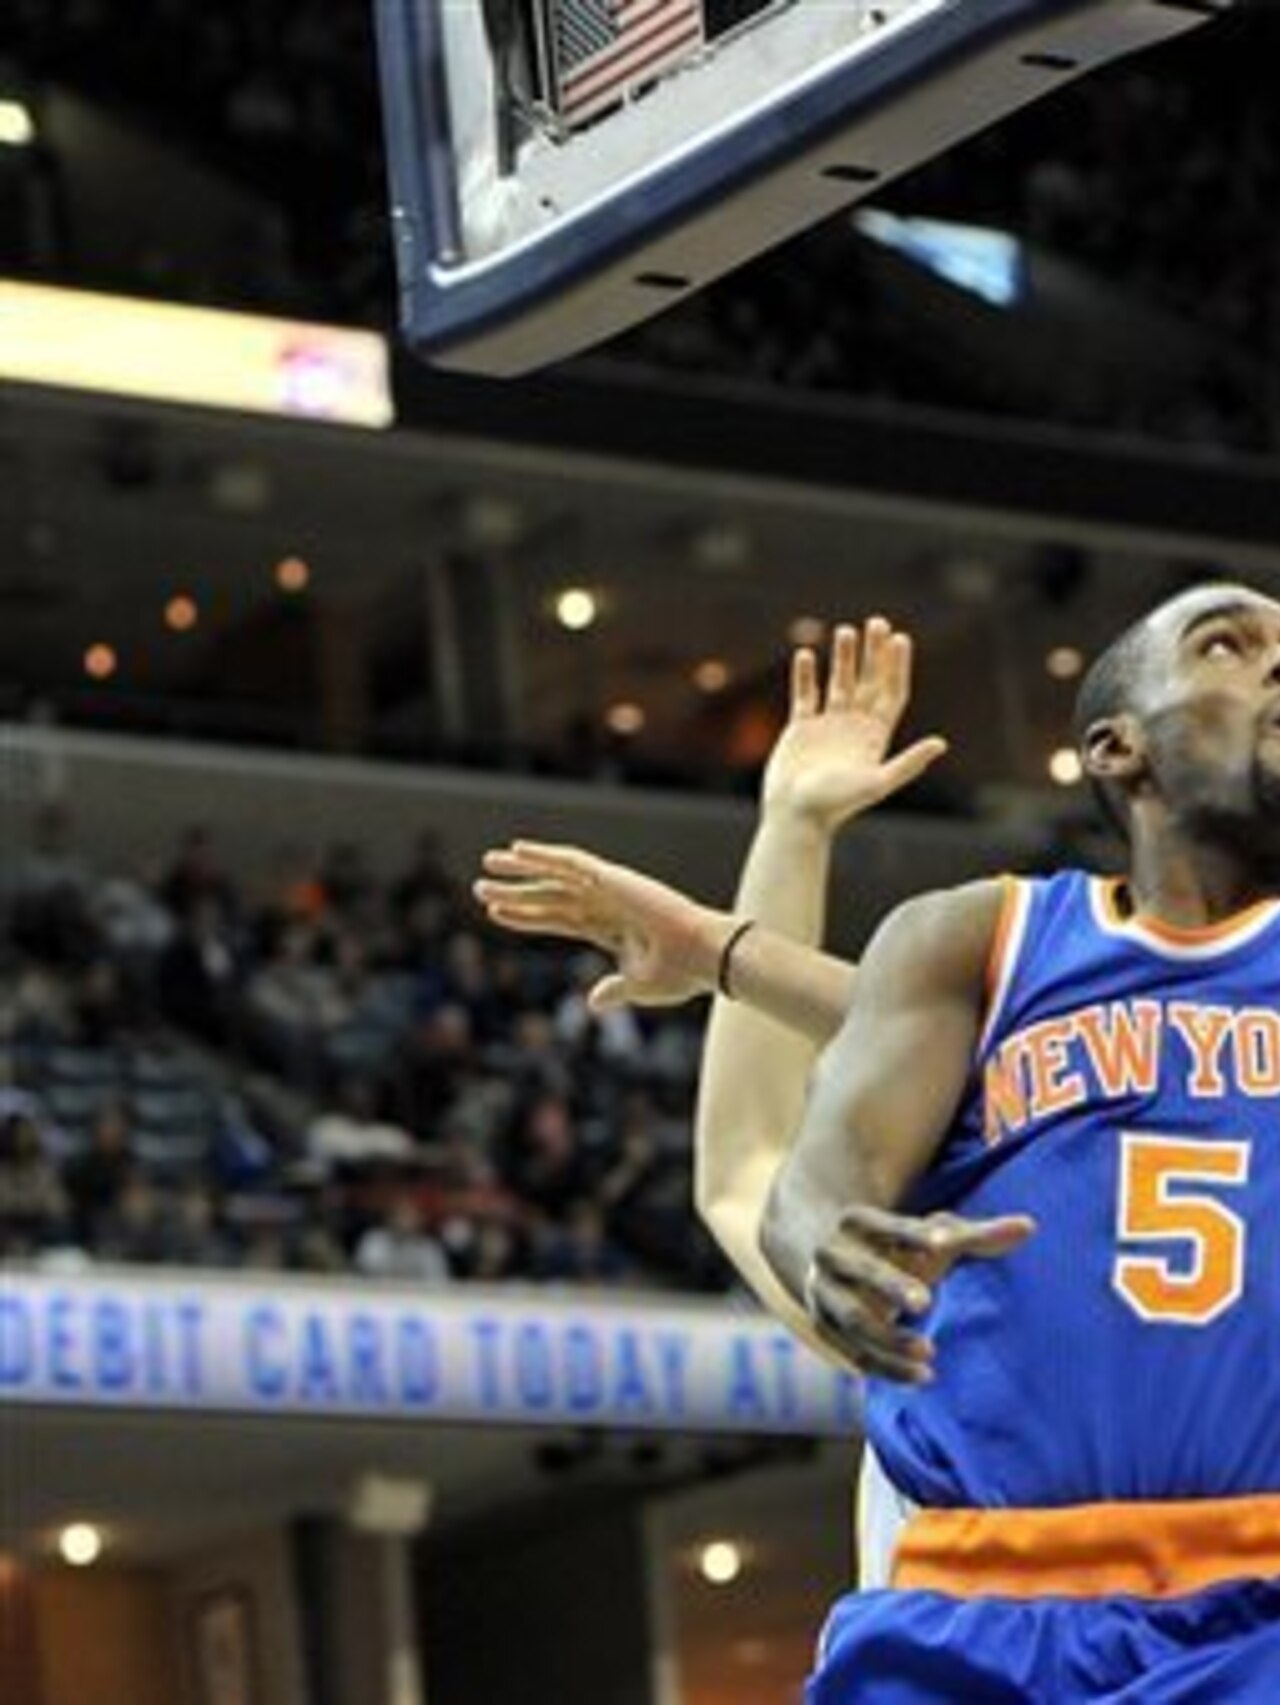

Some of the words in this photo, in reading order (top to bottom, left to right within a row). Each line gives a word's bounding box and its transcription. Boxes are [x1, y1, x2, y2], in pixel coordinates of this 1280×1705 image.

[983, 999, 1162, 1148] NEW
[1112, 1131, 1252, 1326] 5
[0, 1294, 204, 1396] DEBIT
[245, 1302, 440, 1405] CARD
[471, 1316, 690, 1418] TODAY
[729, 1332, 801, 1423] AT
